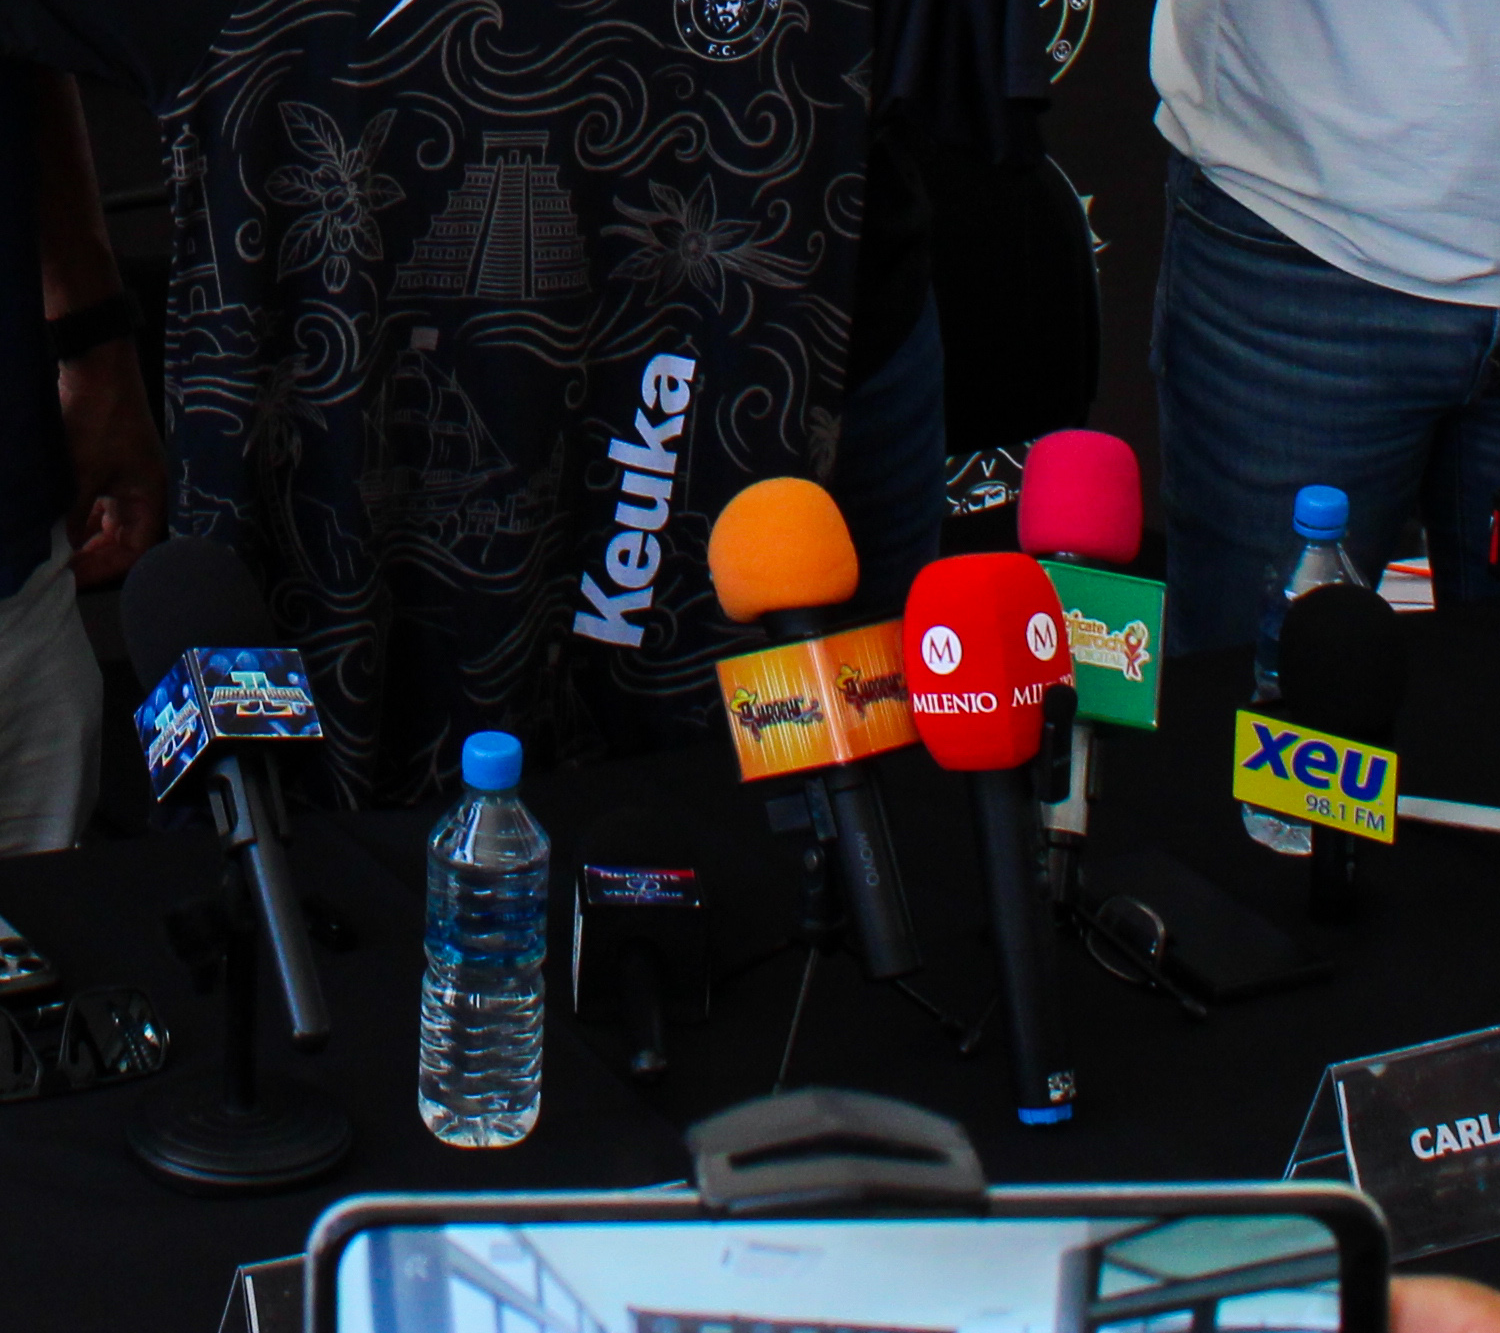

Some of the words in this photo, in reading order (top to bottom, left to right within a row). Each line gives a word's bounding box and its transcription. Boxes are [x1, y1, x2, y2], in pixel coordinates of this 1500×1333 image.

[574, 352, 696, 647] Keuka
[913, 692, 998, 714] MILENIO
[1240, 721, 1388, 802] xeu
[1305, 793, 1346, 820] 98.1
[1354, 806, 1386, 832] FM
